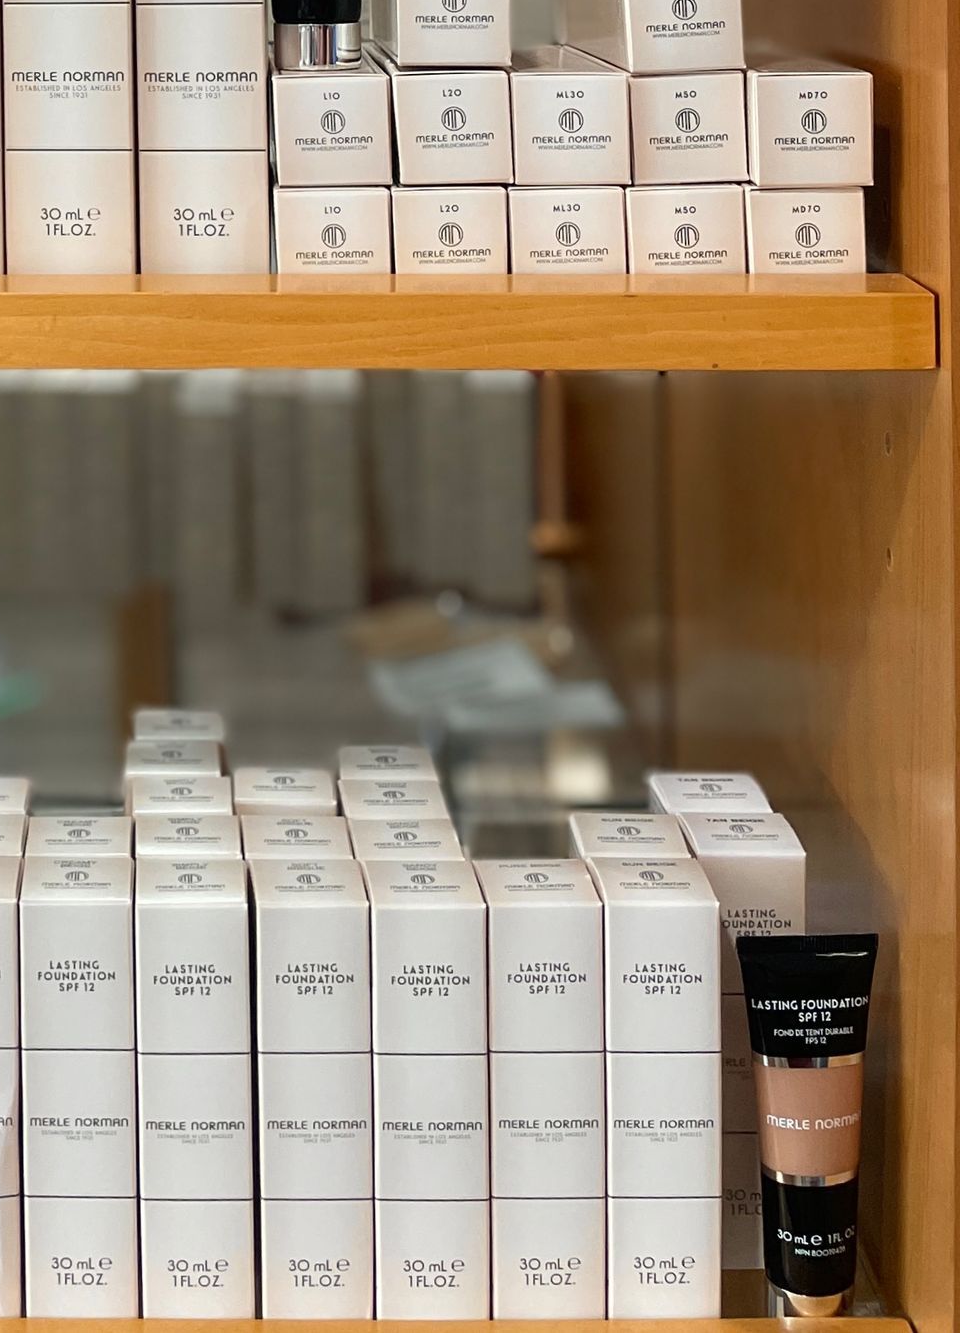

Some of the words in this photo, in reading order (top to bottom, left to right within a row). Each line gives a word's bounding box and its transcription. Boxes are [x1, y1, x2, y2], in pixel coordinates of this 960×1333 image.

[415, 15, 447, 23] MERLE
[451, 15, 494, 25] NORMAN
[323, 92, 340, 100] L10
[442, 89, 462, 97] L20
[556, 90, 584, 99] ML30
[675, 90, 697, 99] M50
[799, 91, 828, 99] MD70
[295, 137, 327, 145] MERLE
[330, 136, 373, 147] NORMAN
[532, 136, 565, 146] MERLE
[567, 135, 612, 146] NORMAN
[324, 206, 341, 214] L10
[440, 204, 459, 213] L20
[553, 203, 581, 212] ML30
[675, 206, 696, 214] M50
[792, 205, 821, 213] MD70
[728, 909, 776, 918] LASTING
[722, 920, 791, 929] OUNDATION
[49, 960, 99, 970] LASTING
[635, 963, 686, 973] LASTING
[38, 971, 116, 983] FOUNDATION
[623, 974, 702, 984] FOUNDATION
[59, 982, 79, 992] SPF
[84, 982, 95, 992] 12
[751, 998, 798, 1010] LASTING
[801, 995, 869, 1009] FOUNDATION
[798, 1012, 818, 1022] SPF
[821, 1011, 831, 1022] 12
[774, 1029, 794, 1037] FOND
[795, 1029, 804, 1037] DE
[806, 1028, 823, 1036] TEINT
[825, 1026, 854, 1036] DURABLE
[805, 1037, 818, 1045] FPS
[30, 1117, 70, 1127] MERLE
[75, 1117, 129, 1127] NORMAN
[767, 1115, 810, 1130] MERLE
[777, 1229, 791, 1241] 30
[795, 1235, 809, 1245] mL
